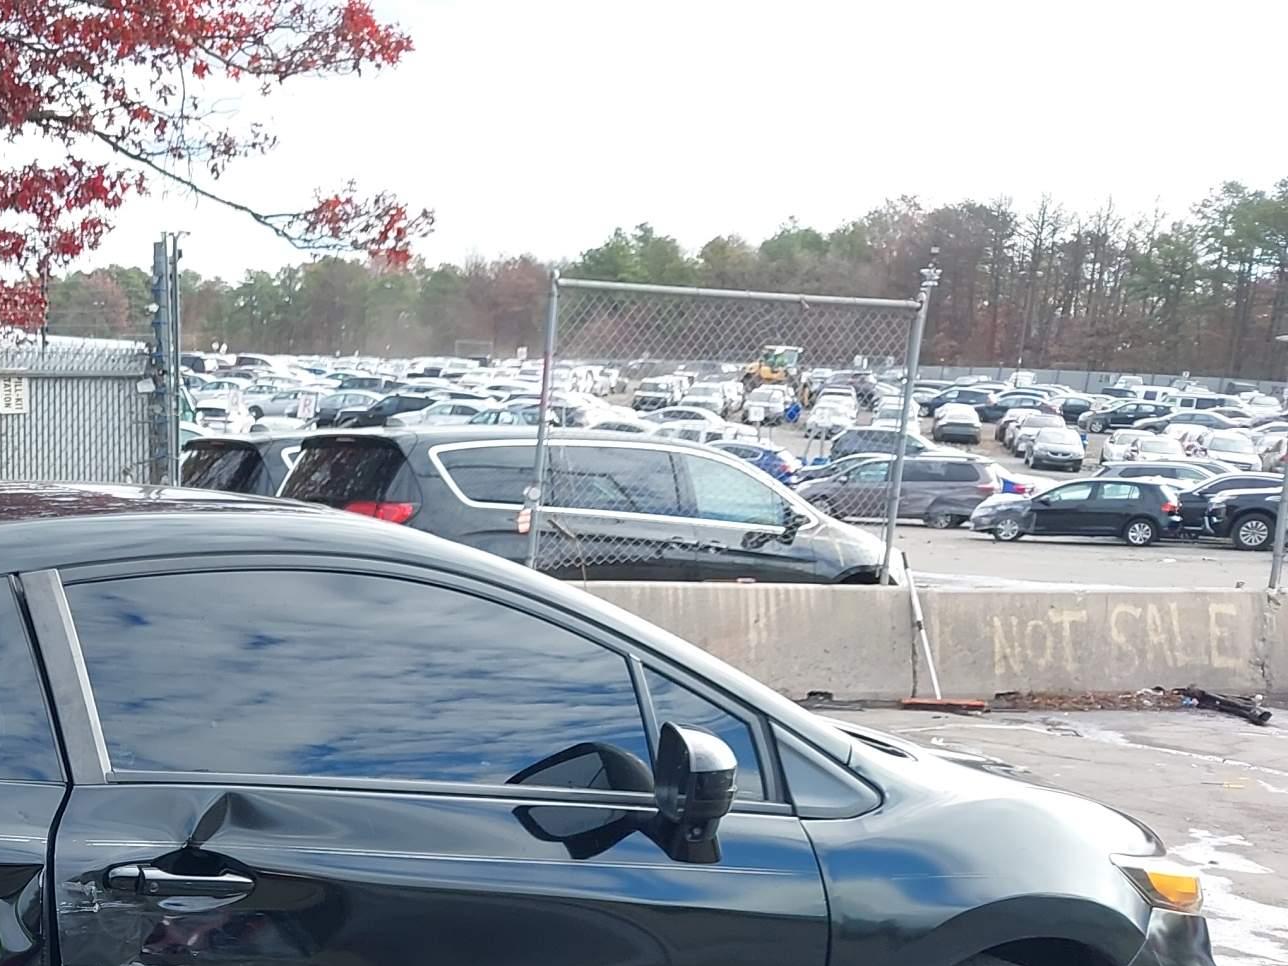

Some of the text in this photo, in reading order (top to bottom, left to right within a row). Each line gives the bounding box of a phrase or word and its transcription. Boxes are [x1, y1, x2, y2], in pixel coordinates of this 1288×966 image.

[2, 376, 12, 408] TATION
[14, 376, 24, 410] PILL-KIT
[990, 601, 1244, 675] NOT SALE
